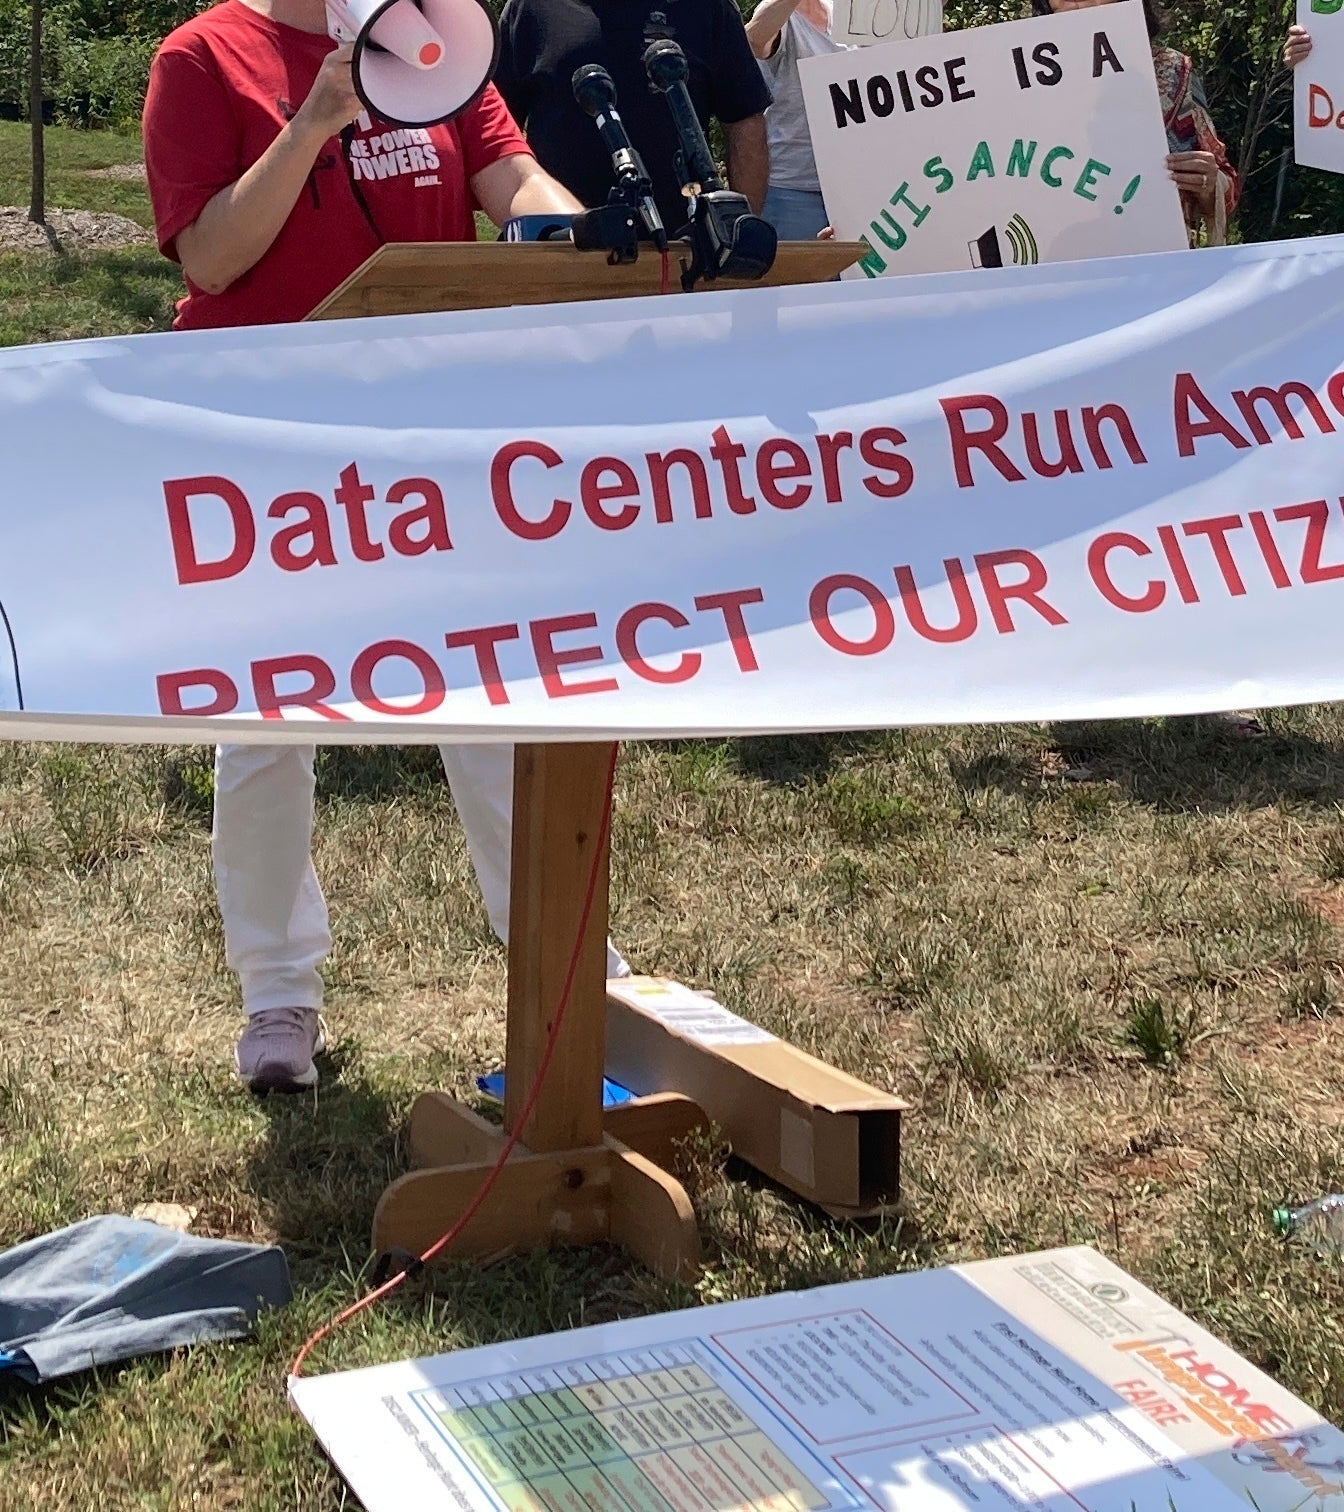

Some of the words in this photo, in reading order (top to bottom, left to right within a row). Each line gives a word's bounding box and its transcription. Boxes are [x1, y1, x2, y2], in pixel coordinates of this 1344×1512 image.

[828, 56, 976, 130] NOISE
[1011, 41, 1064, 90] IS
[1092, 31, 1125, 78] A
[349, 144, 440, 181] TOWERS
[369, 127, 433, 155] POWER
[857, 138, 1142, 279] NUISANCE!
[162, 461, 455, 586] Data
[490, 424, 915, 541] Centers
[939, 394, 1149, 488] Run
[156, 586, 764, 723] PROTECT
[808, 548, 1070, 657] OUR
[1116, 1380, 1192, 1426] FAIRE
[1170, 1351, 1294, 1436] HOME
